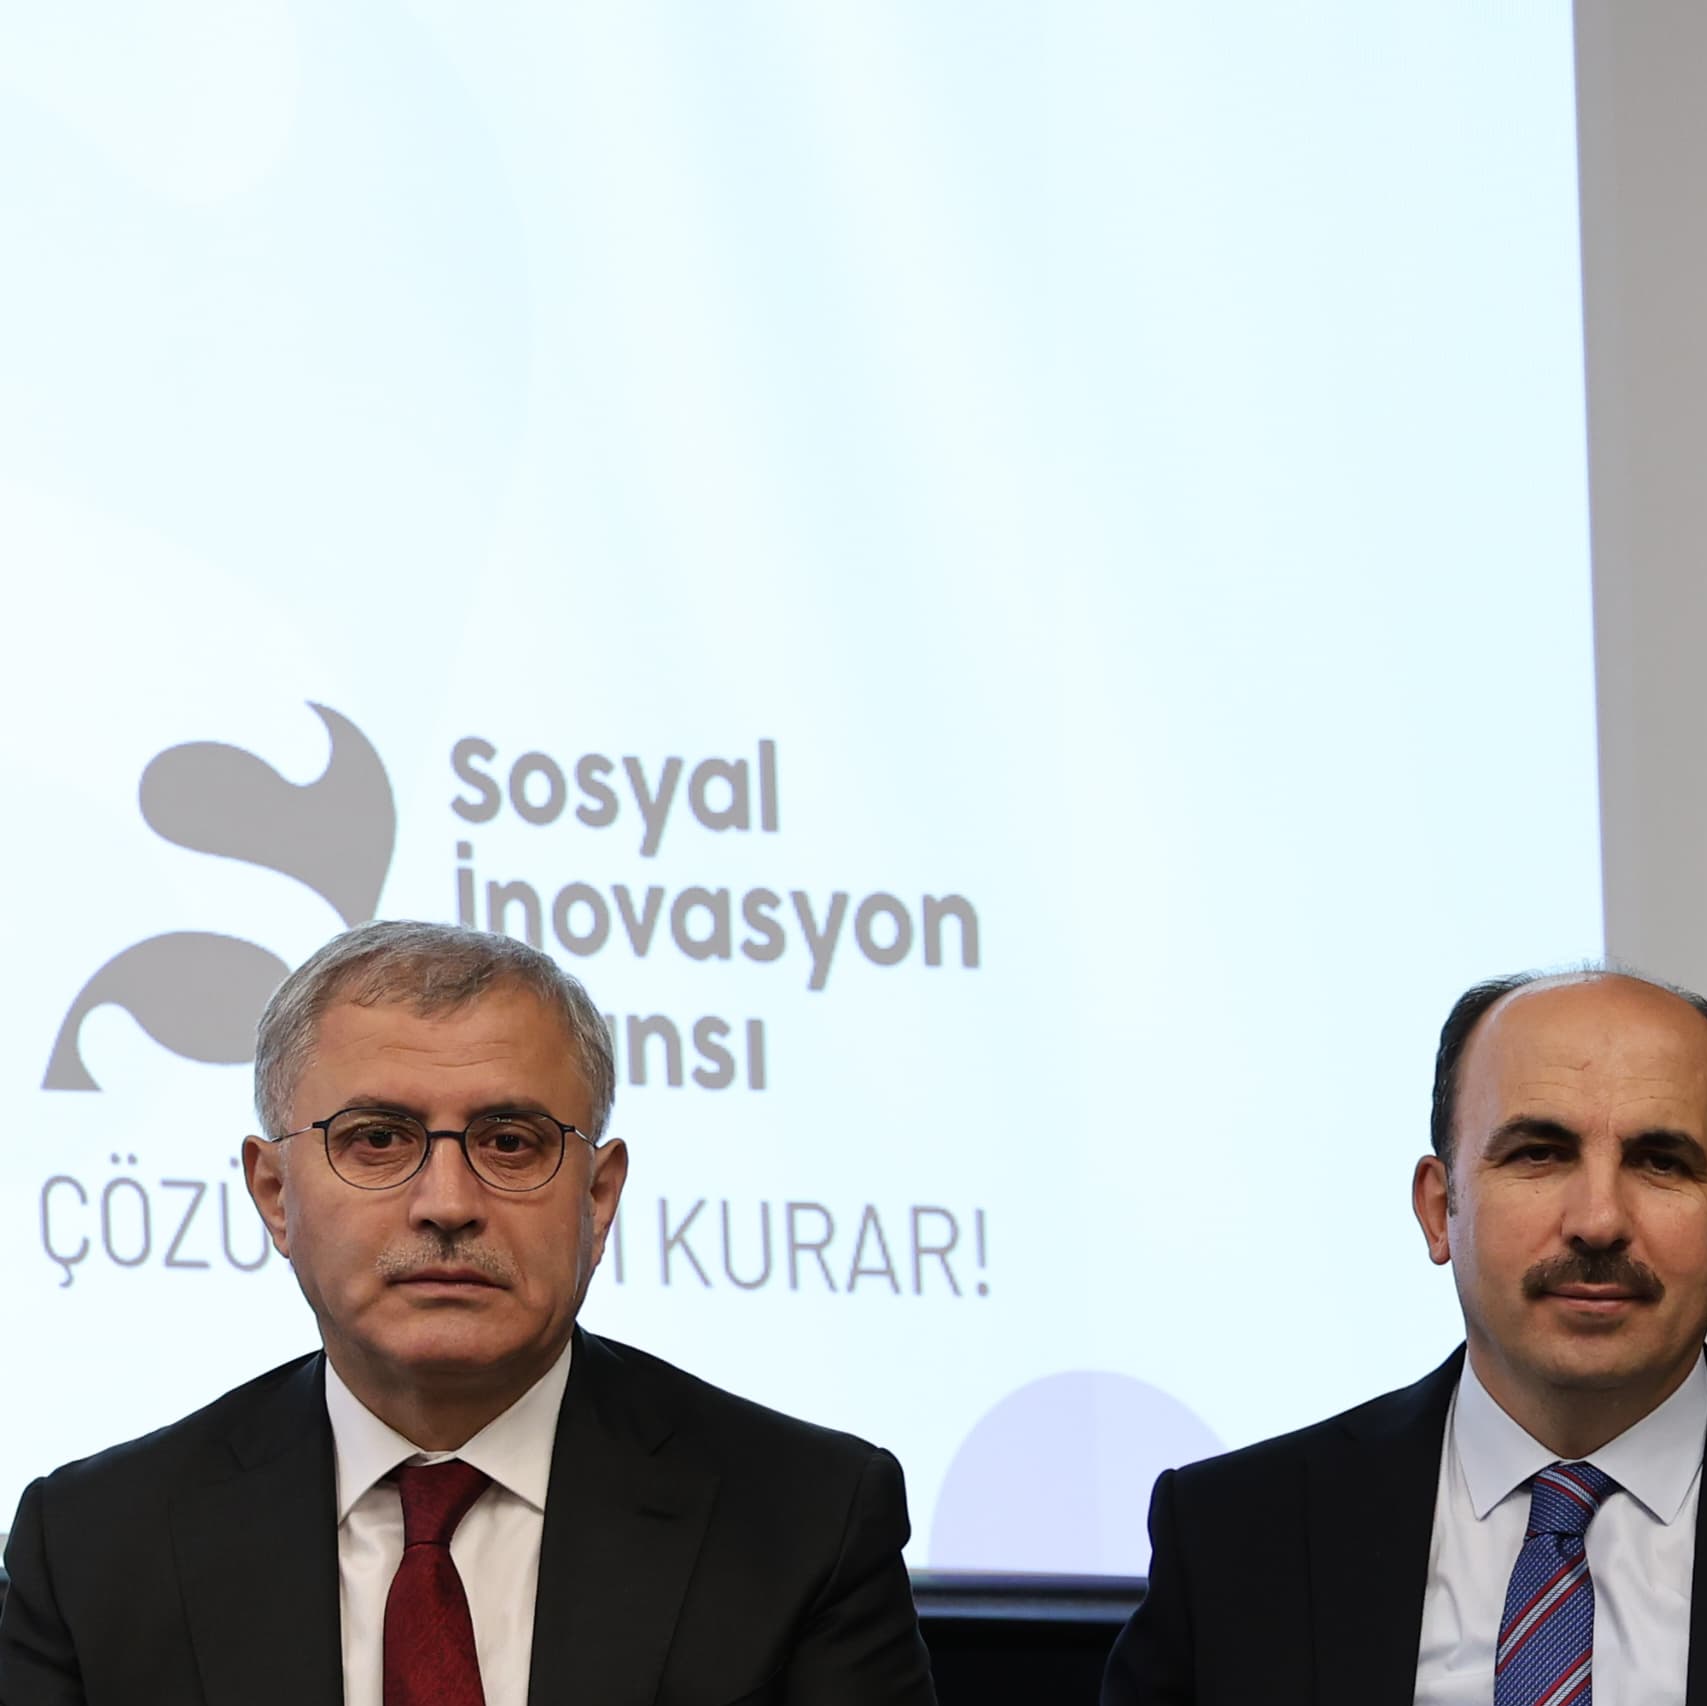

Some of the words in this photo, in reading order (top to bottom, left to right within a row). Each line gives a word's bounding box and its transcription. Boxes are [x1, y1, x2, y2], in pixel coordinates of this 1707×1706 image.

[450, 736, 780, 856] Sosyal
[604, 1014, 767, 1091] nsı
[40, 1153, 270, 1288] ÇÖZÜ
[658, 1198, 990, 1298] KURAR!
